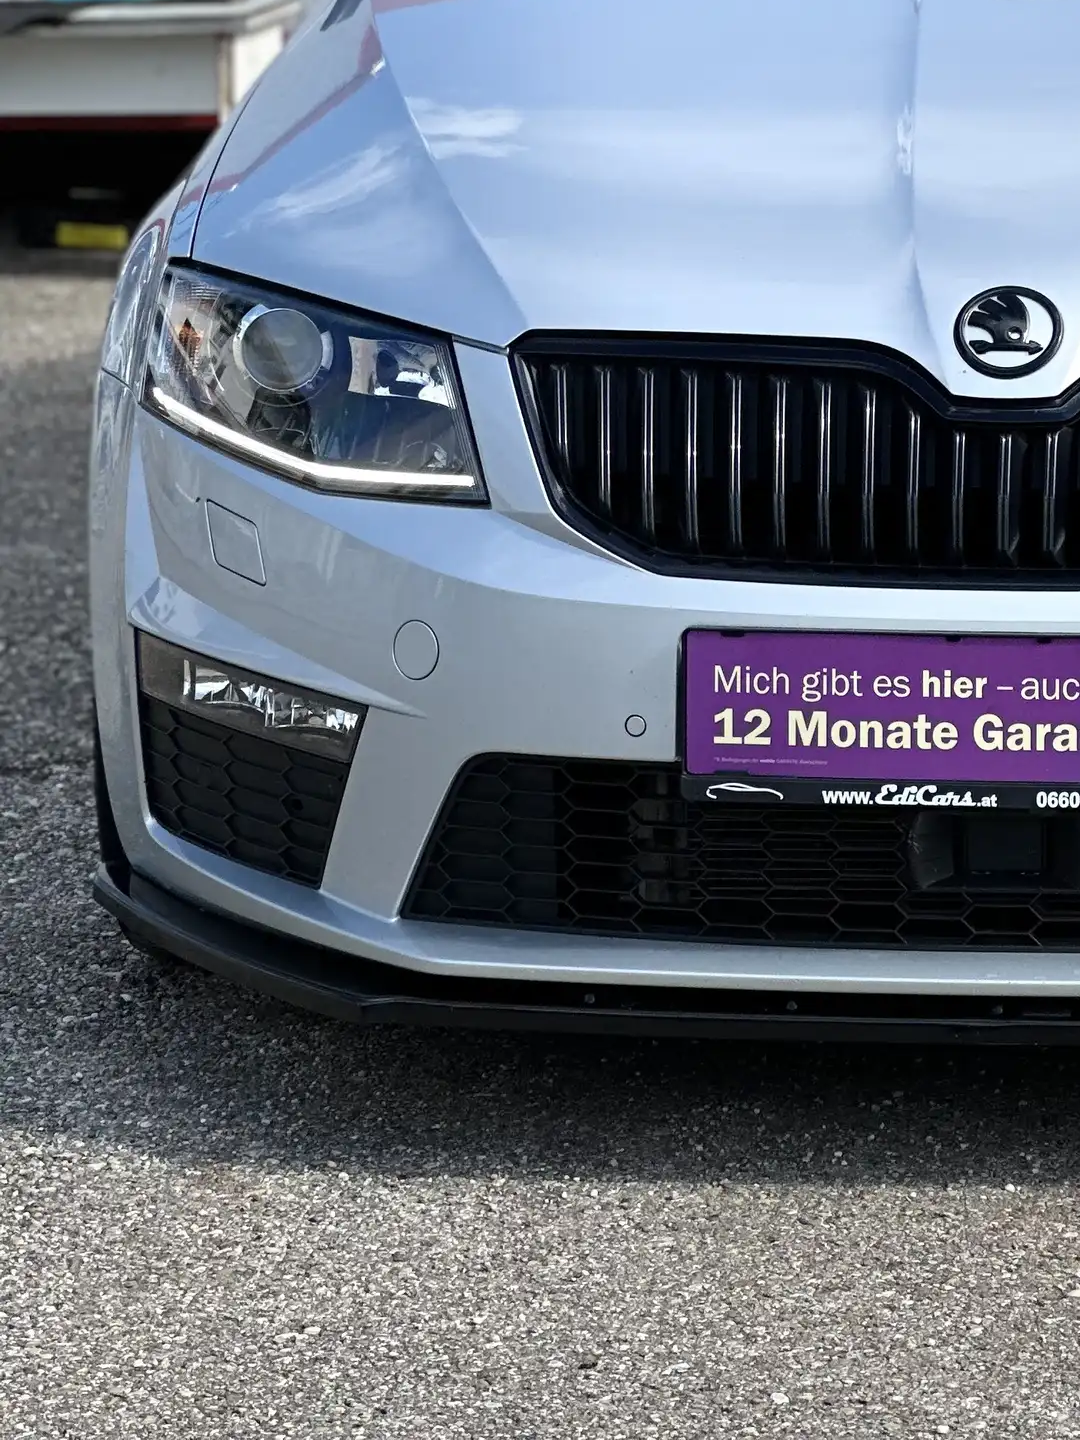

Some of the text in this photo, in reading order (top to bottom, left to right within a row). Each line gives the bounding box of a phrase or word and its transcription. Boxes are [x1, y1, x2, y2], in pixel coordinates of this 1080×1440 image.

[713, 664, 791, 695] Mich
[801, 667, 864, 703] gibt
[873, 674, 912, 698] es
[922, 669, 988, 699] hier
[713, 707, 772, 746] 12
[787, 710, 959, 750] Monate
[822, 783, 998, 809] www.EdiCars.at
[1036, 791, 1080, 809] 0660
